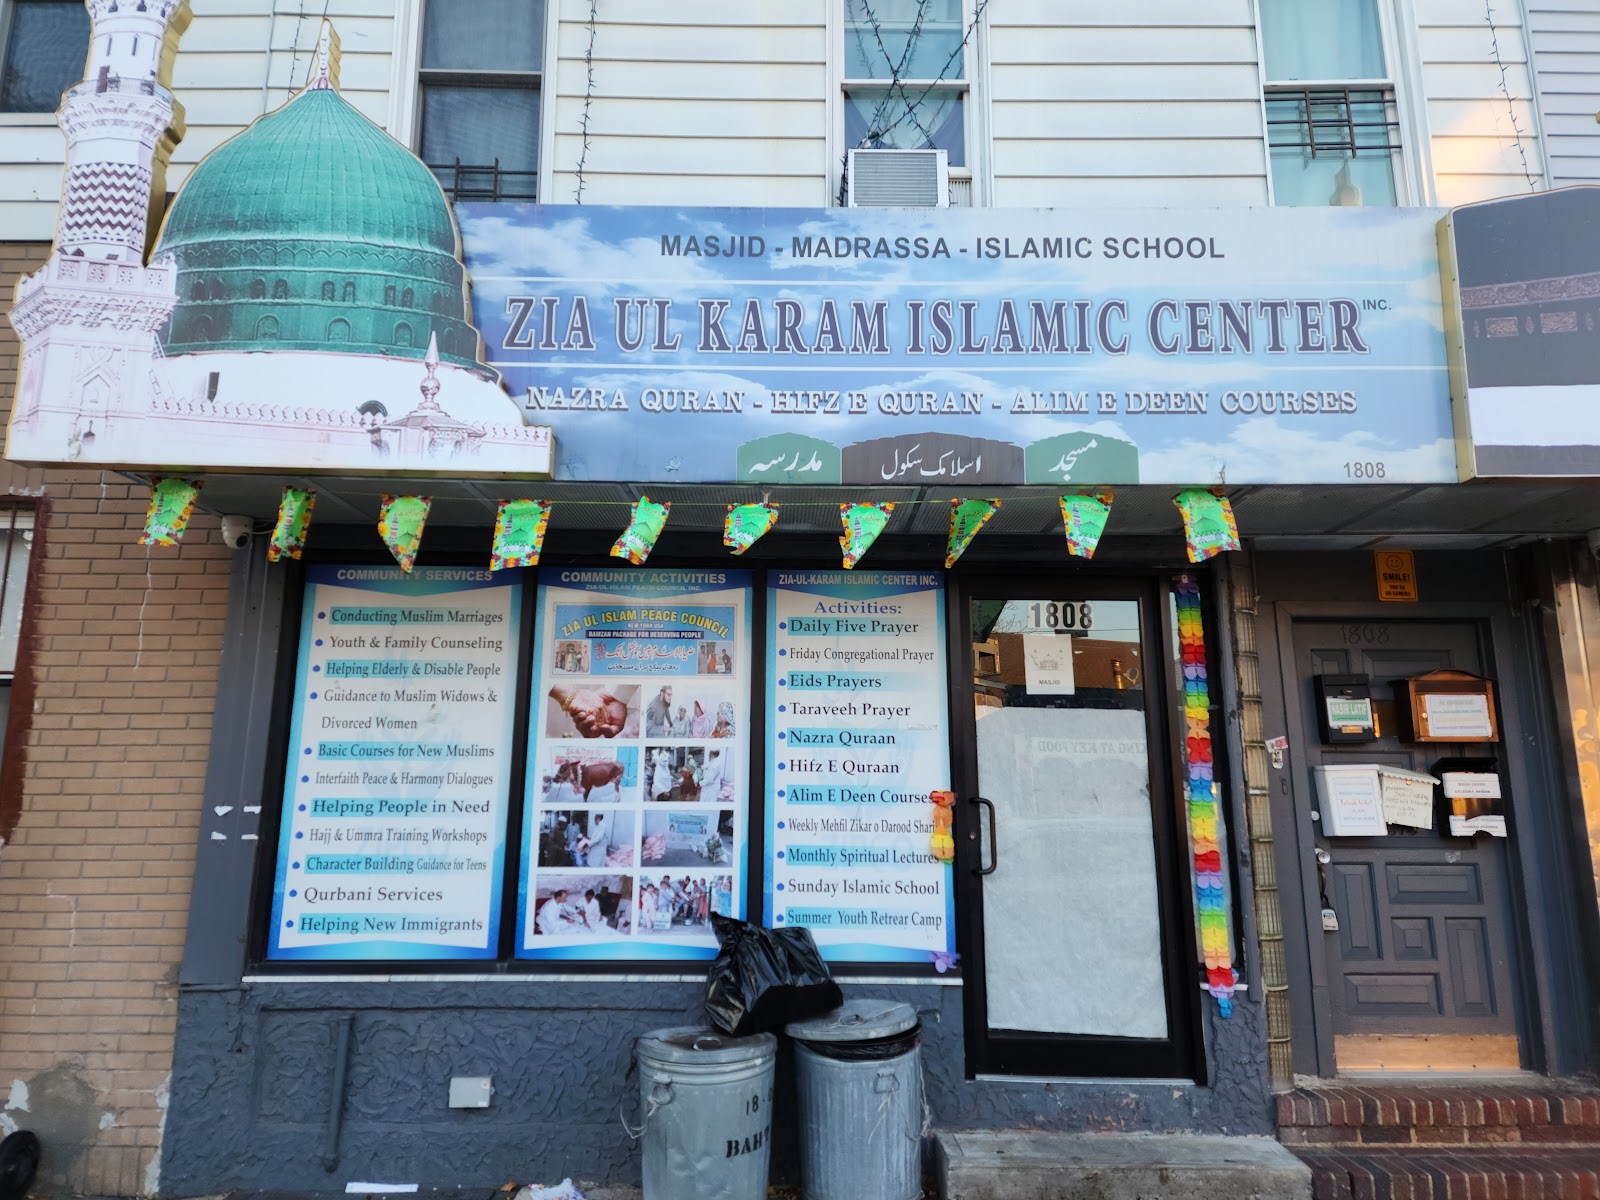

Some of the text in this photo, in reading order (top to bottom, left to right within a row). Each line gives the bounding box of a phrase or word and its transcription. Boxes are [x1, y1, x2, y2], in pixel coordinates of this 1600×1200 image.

[660, 234, 766, 258] MASJID
[791, 236, 951, 259] MADRASSA
[976, 236, 1093, 259] ISLAMIC
[1102, 236, 1225, 259] SCHOOL
[503, 296, 1392, 355] ZIA UL KARAM ISLAMIC CENTER INC.
[525, 386, 628, 412] NAZRA
[640, 388, 745, 414] QURAN
[771, 390, 840, 415] HIFZ
[848, 390, 869, 415] E
[878, 390, 983, 416] QURAN
[1010, 390, 1090, 415] ALIM
[1097, 390, 1119, 415] E
[1125, 390, 1209, 415] DEEN
[1220, 390, 1358, 415] COURSES
[1048, 438, 1098, 481] مسجد
[1343, 461, 1386, 479] 1808
[426, 570, 493, 582] SERVICES
[561, 571, 726, 584] COMMUNITY ACTIVITIES
[779, 574, 938, 585] ZIA-UL-KARAM ISLAMIC CENTER INC.
[1383, 572, 1410, 580] SMILE!
[814, 601, 902, 614] Activities:
[1031, 602, 1093, 628] 1808
[331, 610, 503, 626] Conducting Muslim Marriages
[560, 609, 730, 639] ZIA UL ISLAM PEACE COUNCIL
[790, 620, 919, 636] Daily Five Prayer
[330, 636, 503, 652] Youth & Family Counseling
[789, 648, 934, 664] Friday Congregational Prayer
[326, 663, 501, 678] Helping Elderly & Disable People
[790, 674, 882, 691] Eids Prayers
[324, 689, 498, 702] Guidance to Muslim Widows &
[790, 702, 911, 719] Taraveeh Prayer
[321, 717, 418, 729] Divorced Women
[789, 731, 896, 746] Nazra Quraan
[318, 744, 494, 757] Basic Courses for New Muslims
[789, 759, 900, 775] Hifz E Quraan
[315, 772, 493, 788] Interfaith Peace & Harmony Dialogues
[789, 789, 823, 803] Alim
[828, 789, 836, 803] E
[840, 790, 876, 803] Deen
[313, 800, 490, 816] Helping People in Need
[788, 818, 936, 836] Weekly Mehfil Zikar o Darood Shari
[309, 828, 487, 845] Hajj & Ummra Training Workshops
[306, 857, 487, 873] Character Building Guidance for Teens
[788, 848, 940, 866] Monthly Spiritual Lectures
[303, 887, 443, 903] Qurbani Services
[788, 879, 940, 897] Sunday Islamic School
[300, 918, 483, 934] Helping New Immigrants
[788, 910, 832, 924] Summer
[837, 910, 867, 925] Youth
[911, 911, 942, 930] Camp
